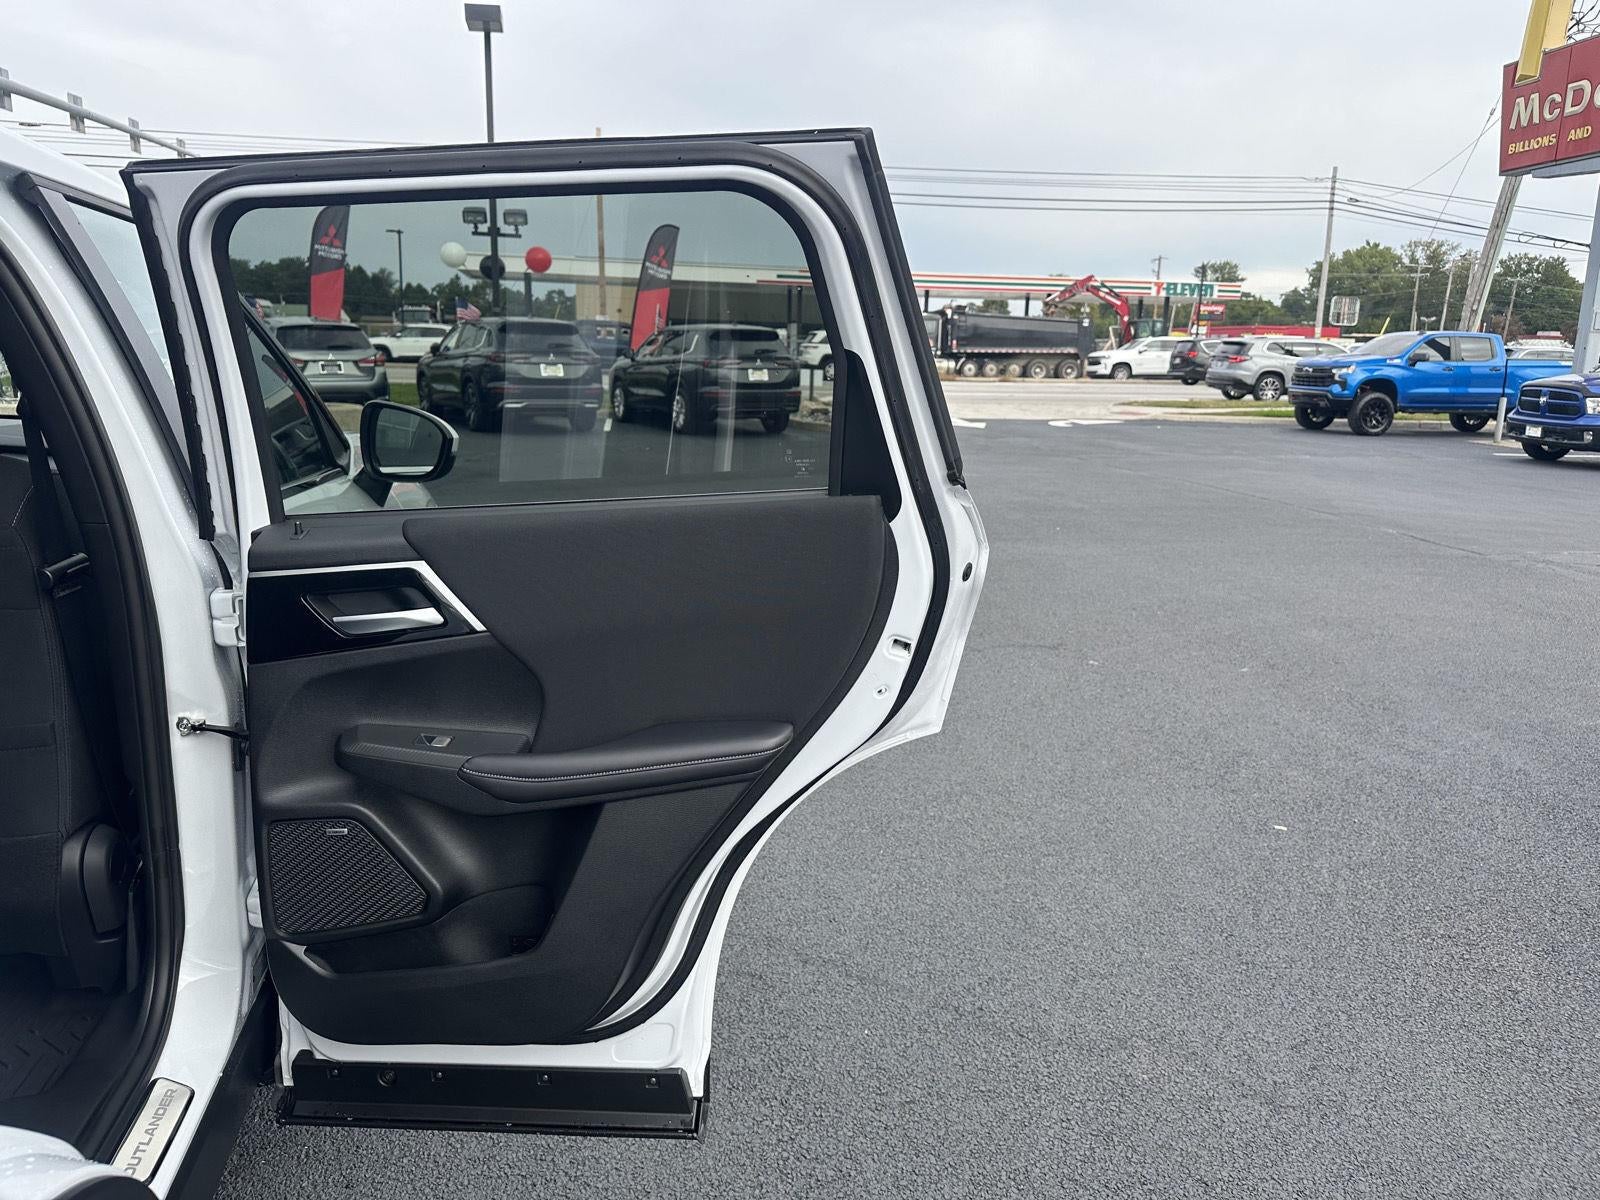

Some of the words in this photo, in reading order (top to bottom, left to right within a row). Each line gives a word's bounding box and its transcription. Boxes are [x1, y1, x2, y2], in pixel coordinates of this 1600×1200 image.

[1509, 79, 1600, 131] McD
[1508, 133, 1557, 155] BILLIONS
[1567, 125, 1592, 142] AND
[124, 1087, 178, 1176] OUTLANDER
